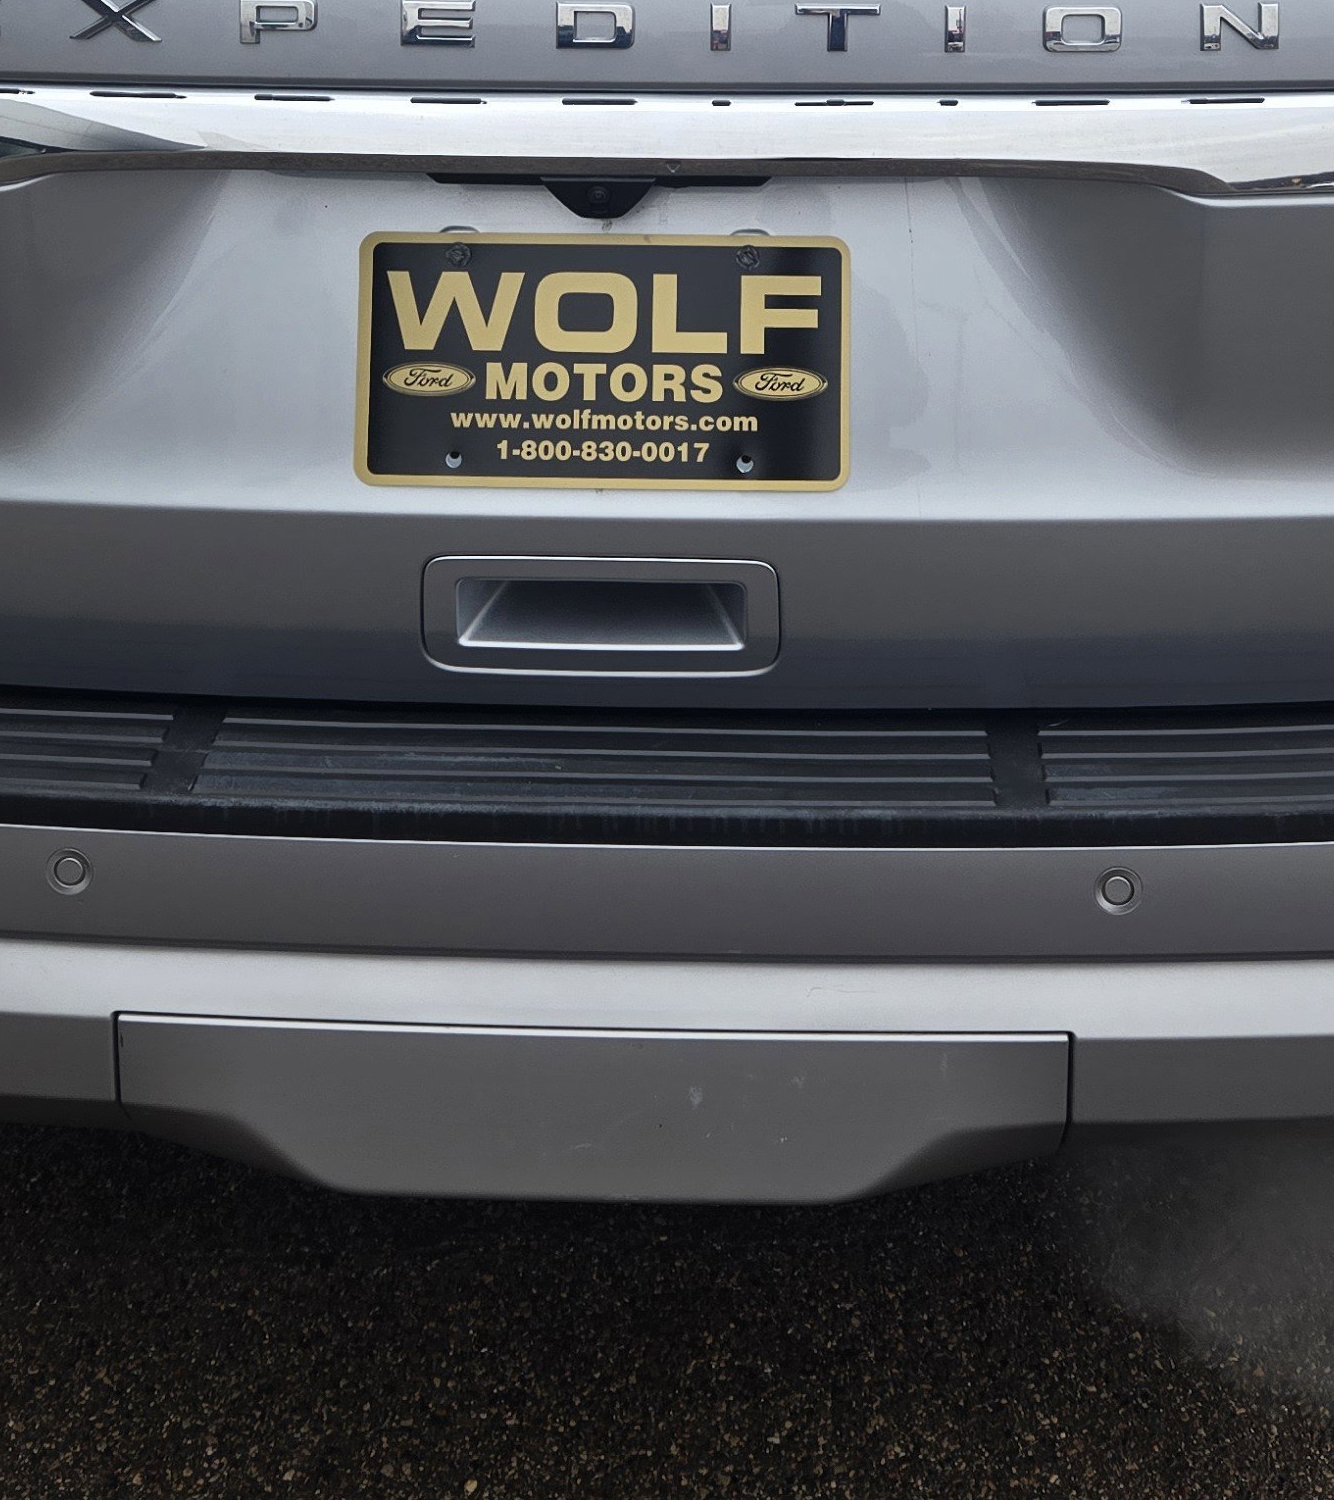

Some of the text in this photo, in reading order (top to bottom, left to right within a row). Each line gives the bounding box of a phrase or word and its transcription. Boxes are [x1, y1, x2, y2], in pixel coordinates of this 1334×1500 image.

[386, 270, 823, 355] WOLF
[403, 367, 454, 387] Ford
[485, 362, 724, 403] MOTORS
[754, 372, 806, 392] Ford
[450, 410, 759, 433] www.wolfmotors.com
[497, 440, 710, 463] 1-800-830-0017
